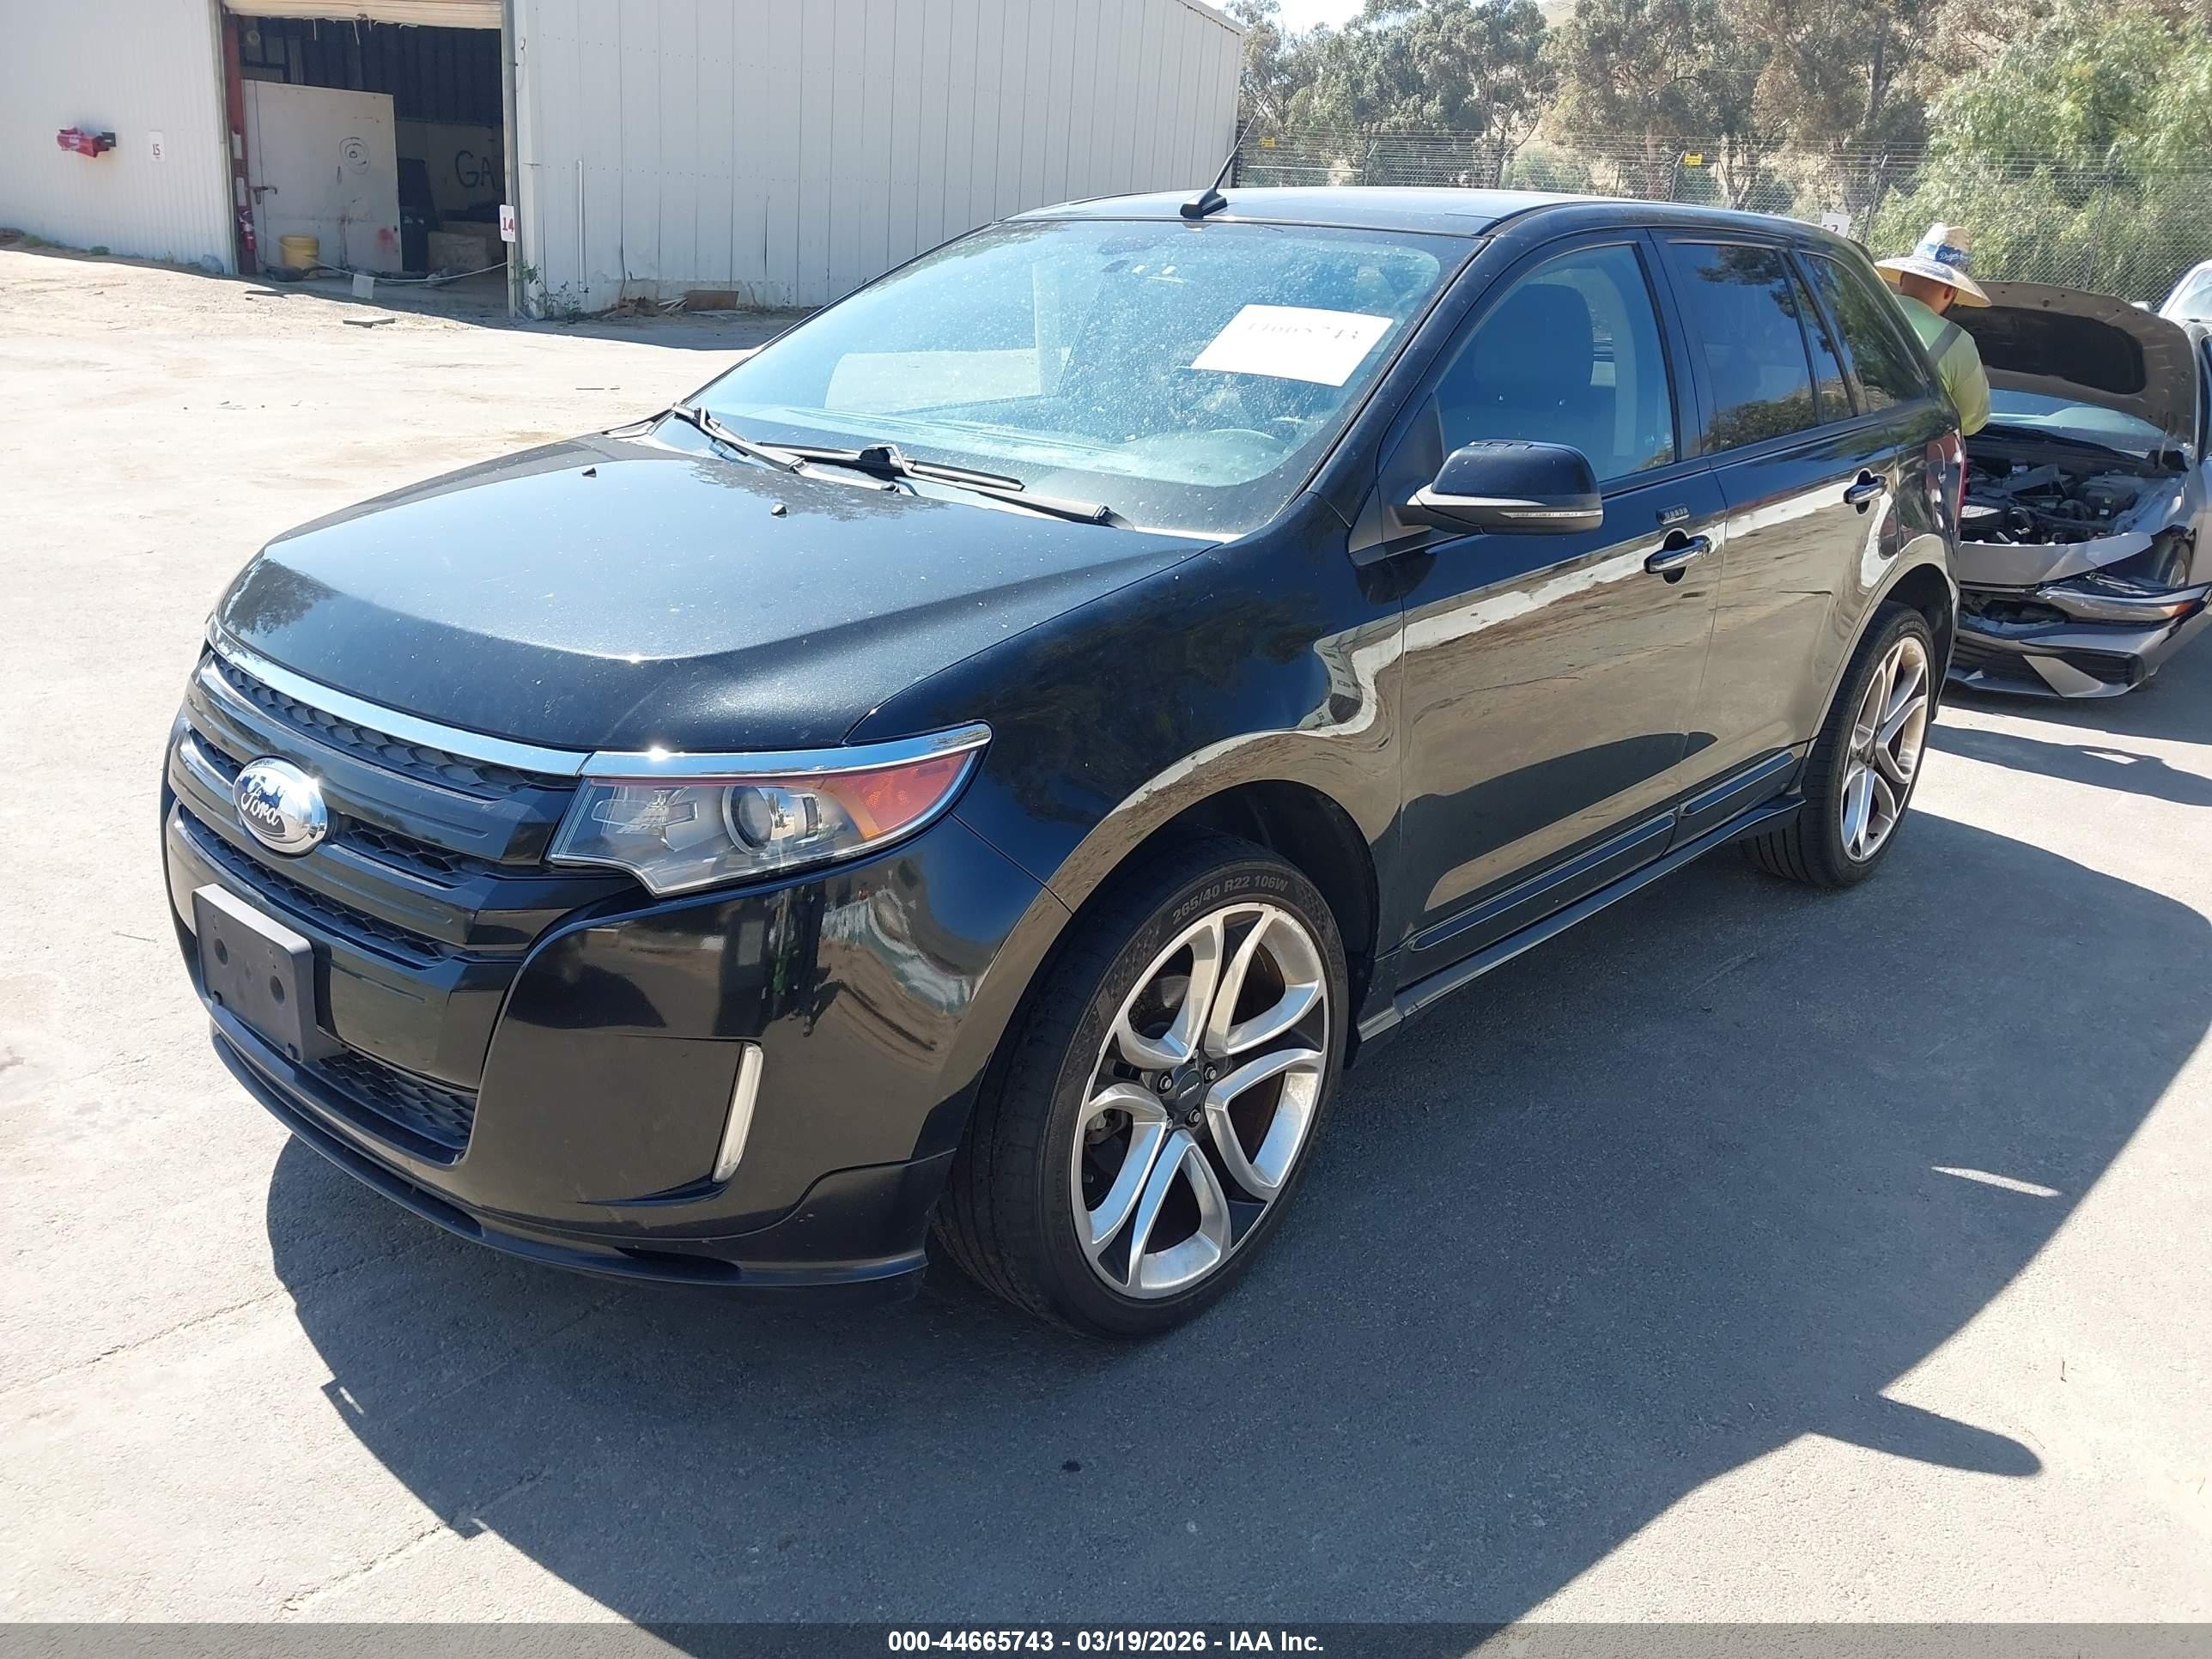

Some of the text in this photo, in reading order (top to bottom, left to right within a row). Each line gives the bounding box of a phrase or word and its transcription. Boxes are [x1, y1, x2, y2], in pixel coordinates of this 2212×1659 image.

[502, 216, 515, 233] 14
[240, 776, 285, 826] Ford
[1172, 875, 1288, 925] 265/40 R22 106W
